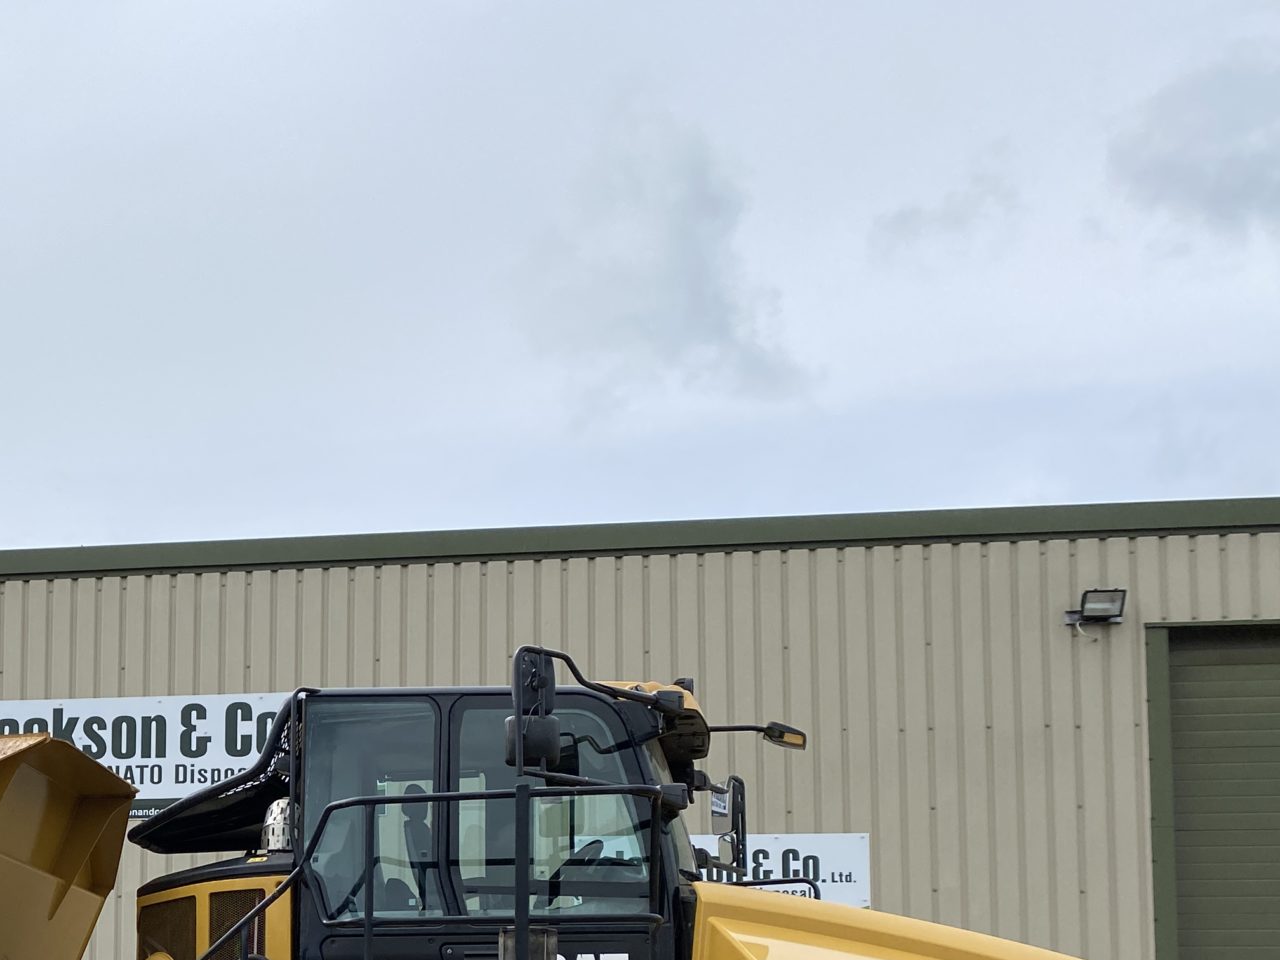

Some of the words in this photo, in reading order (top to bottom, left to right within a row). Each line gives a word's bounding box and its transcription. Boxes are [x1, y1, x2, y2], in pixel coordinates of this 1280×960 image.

[180, 703, 211, 758] &
[752, 849, 773, 881] &
[831, 871, 856, 883] Ltd.
